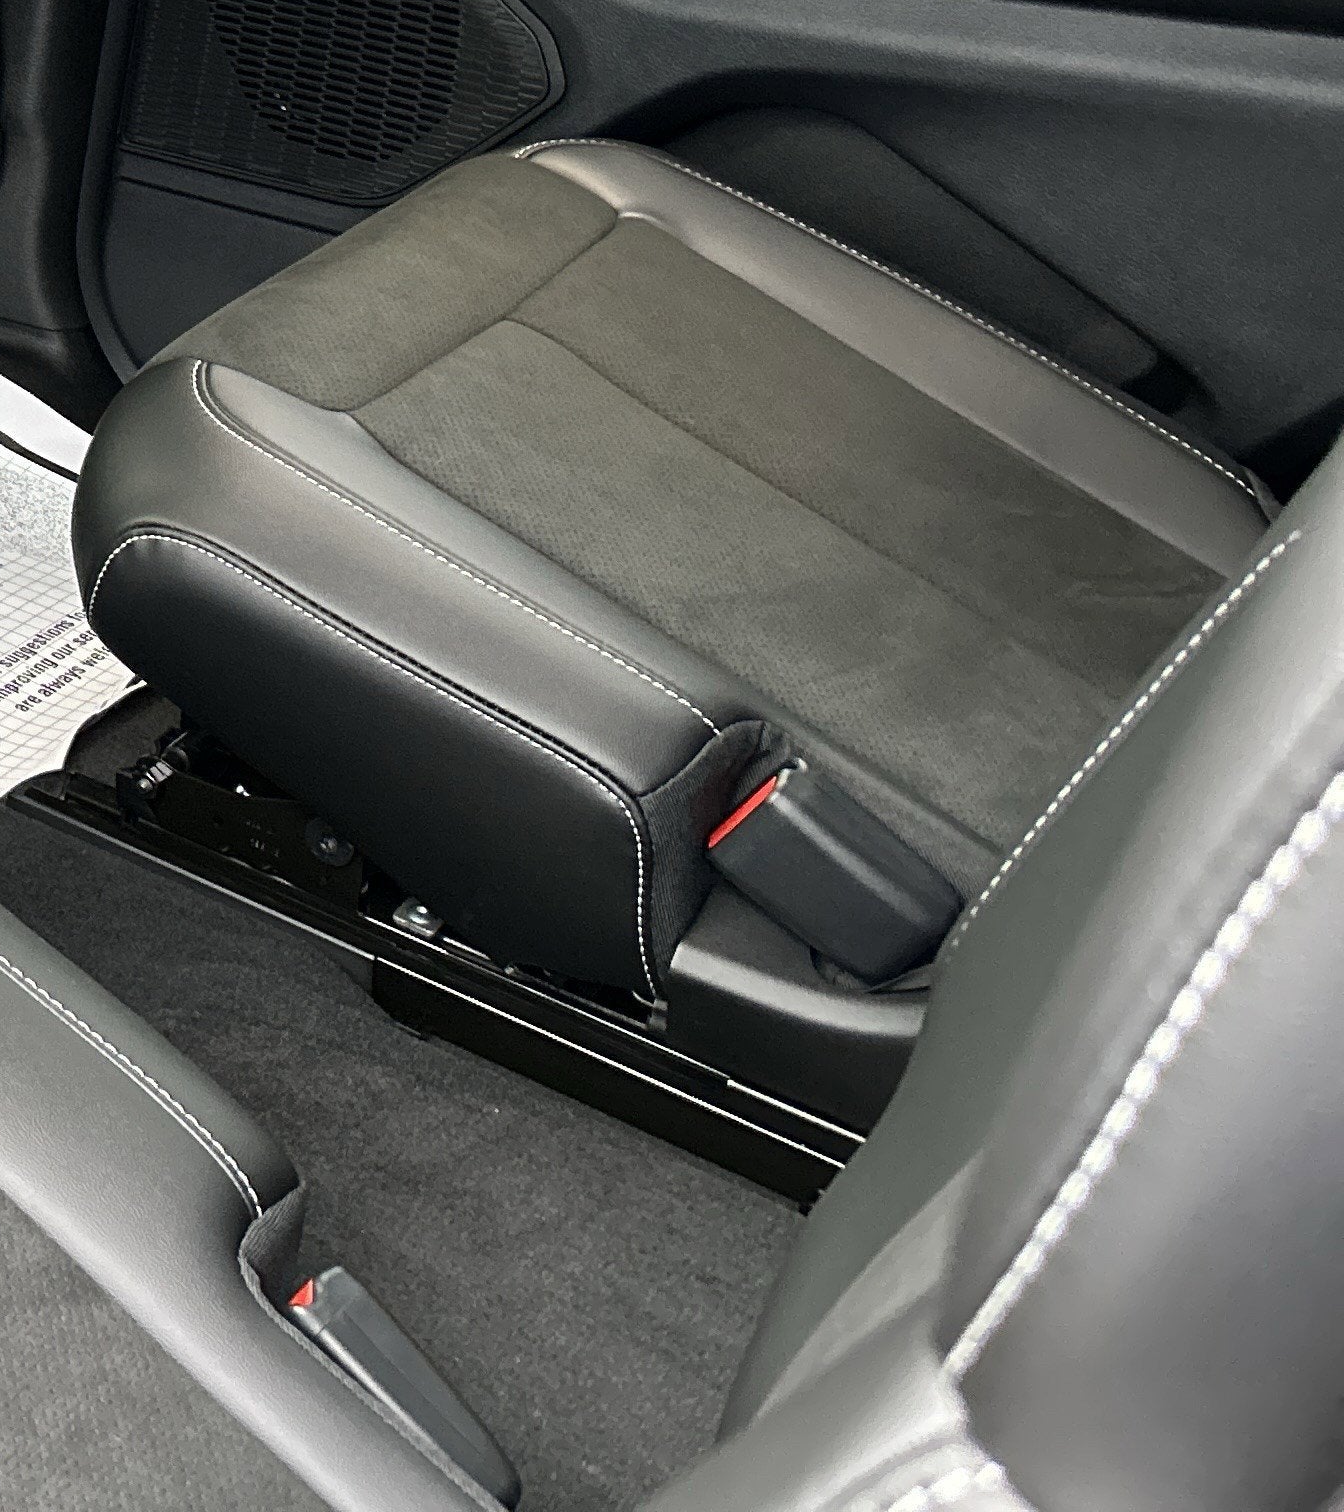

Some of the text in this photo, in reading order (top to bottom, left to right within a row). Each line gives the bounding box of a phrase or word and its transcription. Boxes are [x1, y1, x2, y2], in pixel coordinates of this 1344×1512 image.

[0, 620, 75, 668] suggestions
[66, 611, 86, 622] fo
[52, 643, 75, 660] our
[72, 629, 98, 646] ser
[15, 694, 43, 712] are
[37, 665, 86, 698] always
